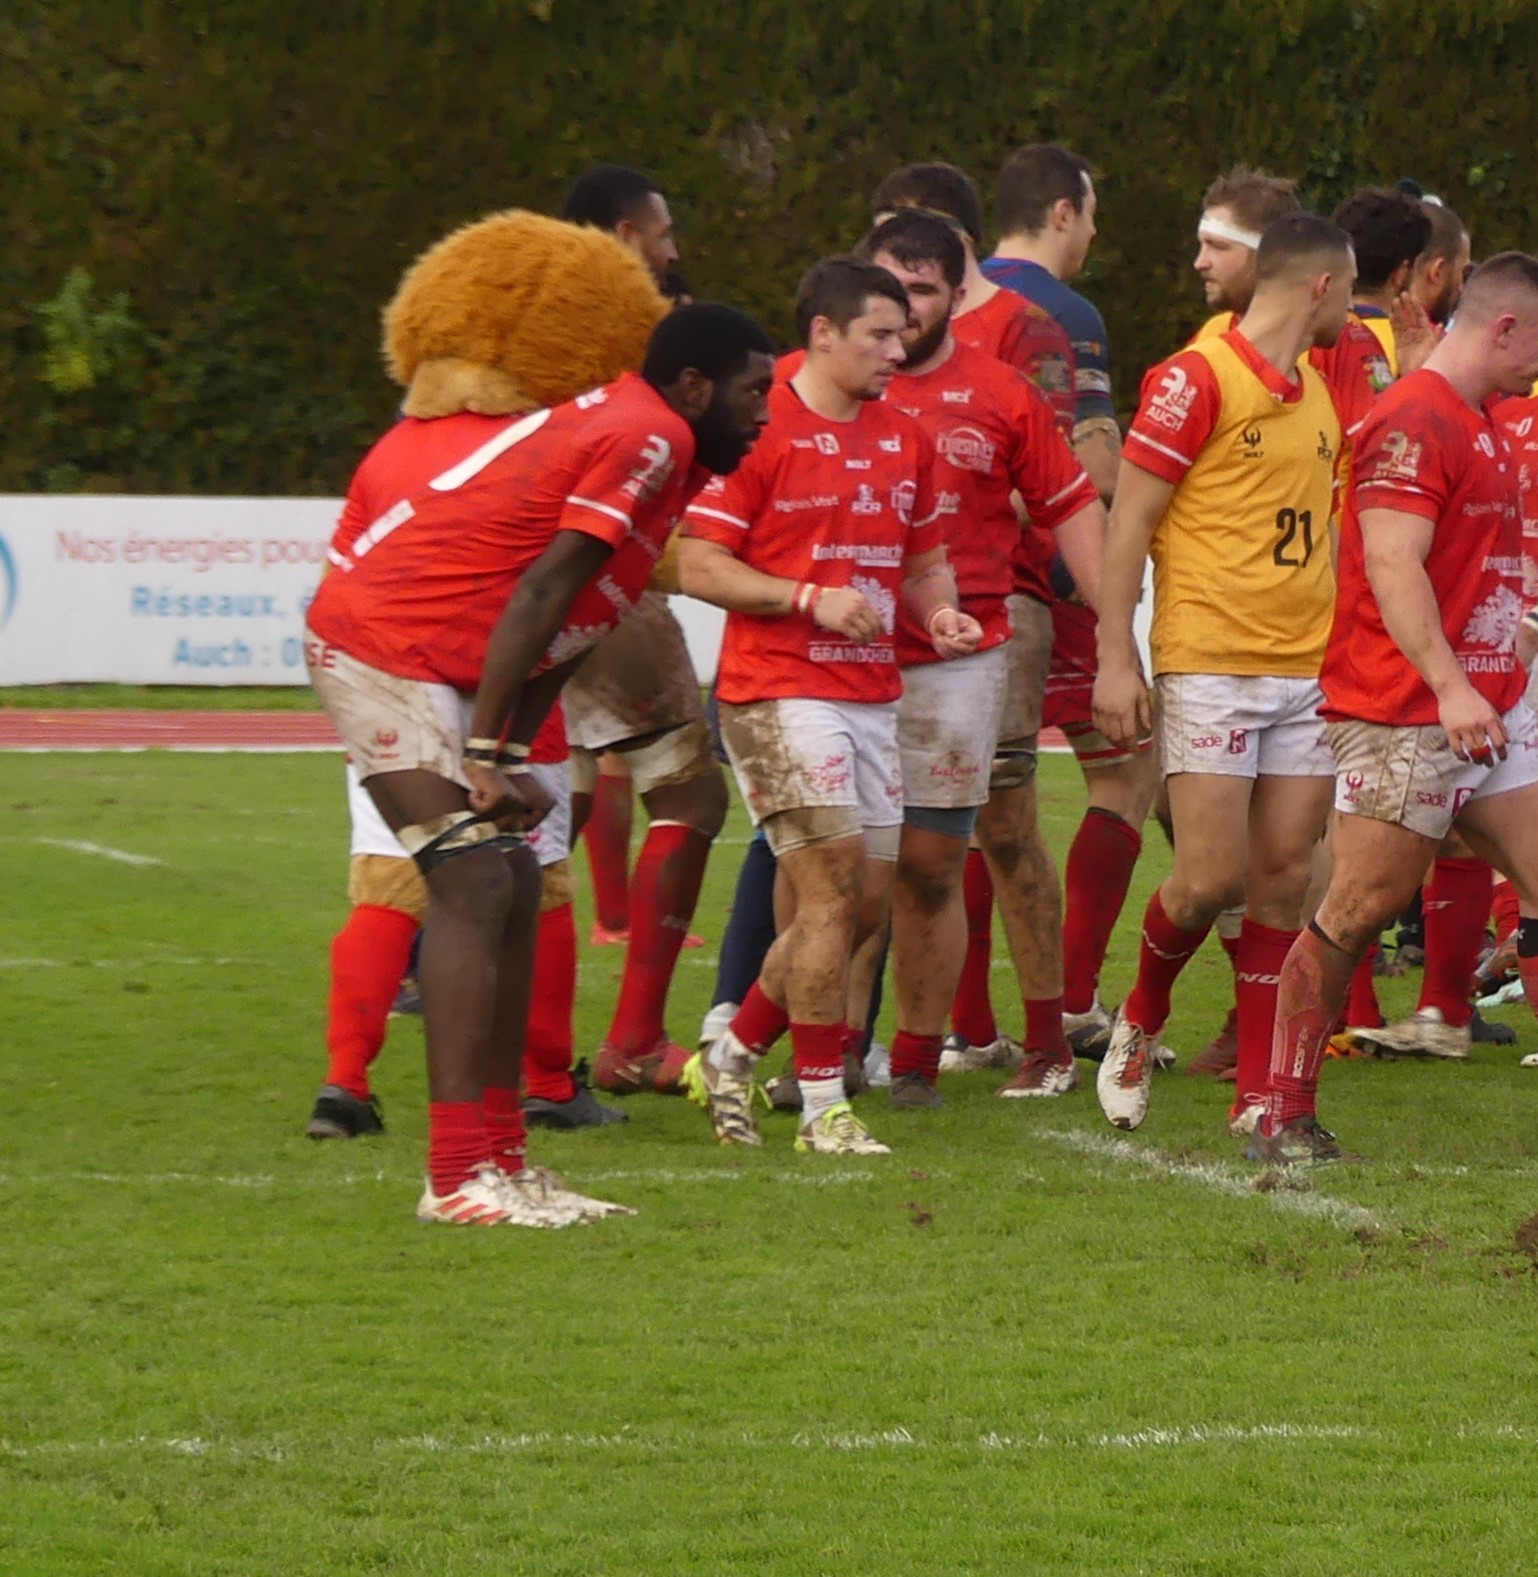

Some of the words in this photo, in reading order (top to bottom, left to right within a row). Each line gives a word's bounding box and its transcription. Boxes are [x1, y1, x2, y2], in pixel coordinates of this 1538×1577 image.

[122, 530, 252, 573] énergies
[1273, 507, 1313, 568] 21
[173, 636, 252, 667] Auch
